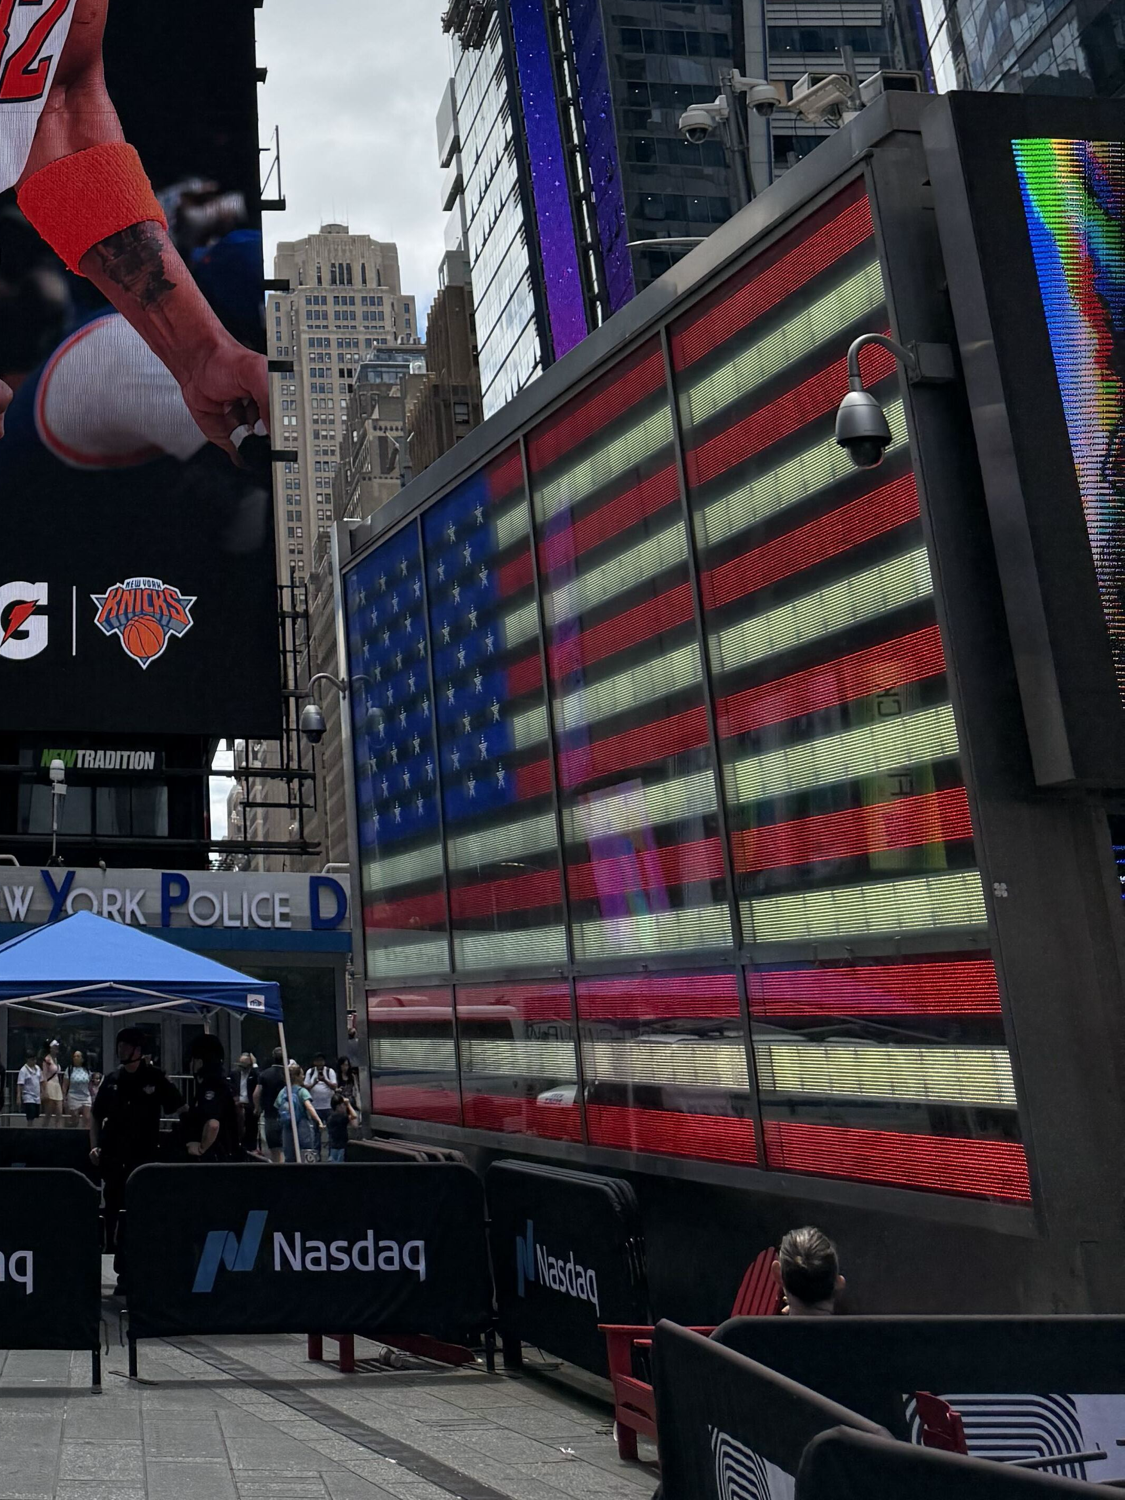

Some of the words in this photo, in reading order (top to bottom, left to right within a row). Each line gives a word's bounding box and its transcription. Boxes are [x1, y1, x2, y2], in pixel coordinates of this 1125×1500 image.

[97, 587, 190, 625] KNICKS
[125, 579, 141, 589] NEW
[142, 579, 162, 589] YORK
[40, 870, 147, 925] YORK
[161, 871, 292, 928] POLICE
[309, 875, 348, 930] D
[274, 1230, 426, 1283] Nasdaq
[535, 1243, 599, 1318] Nasdaq
